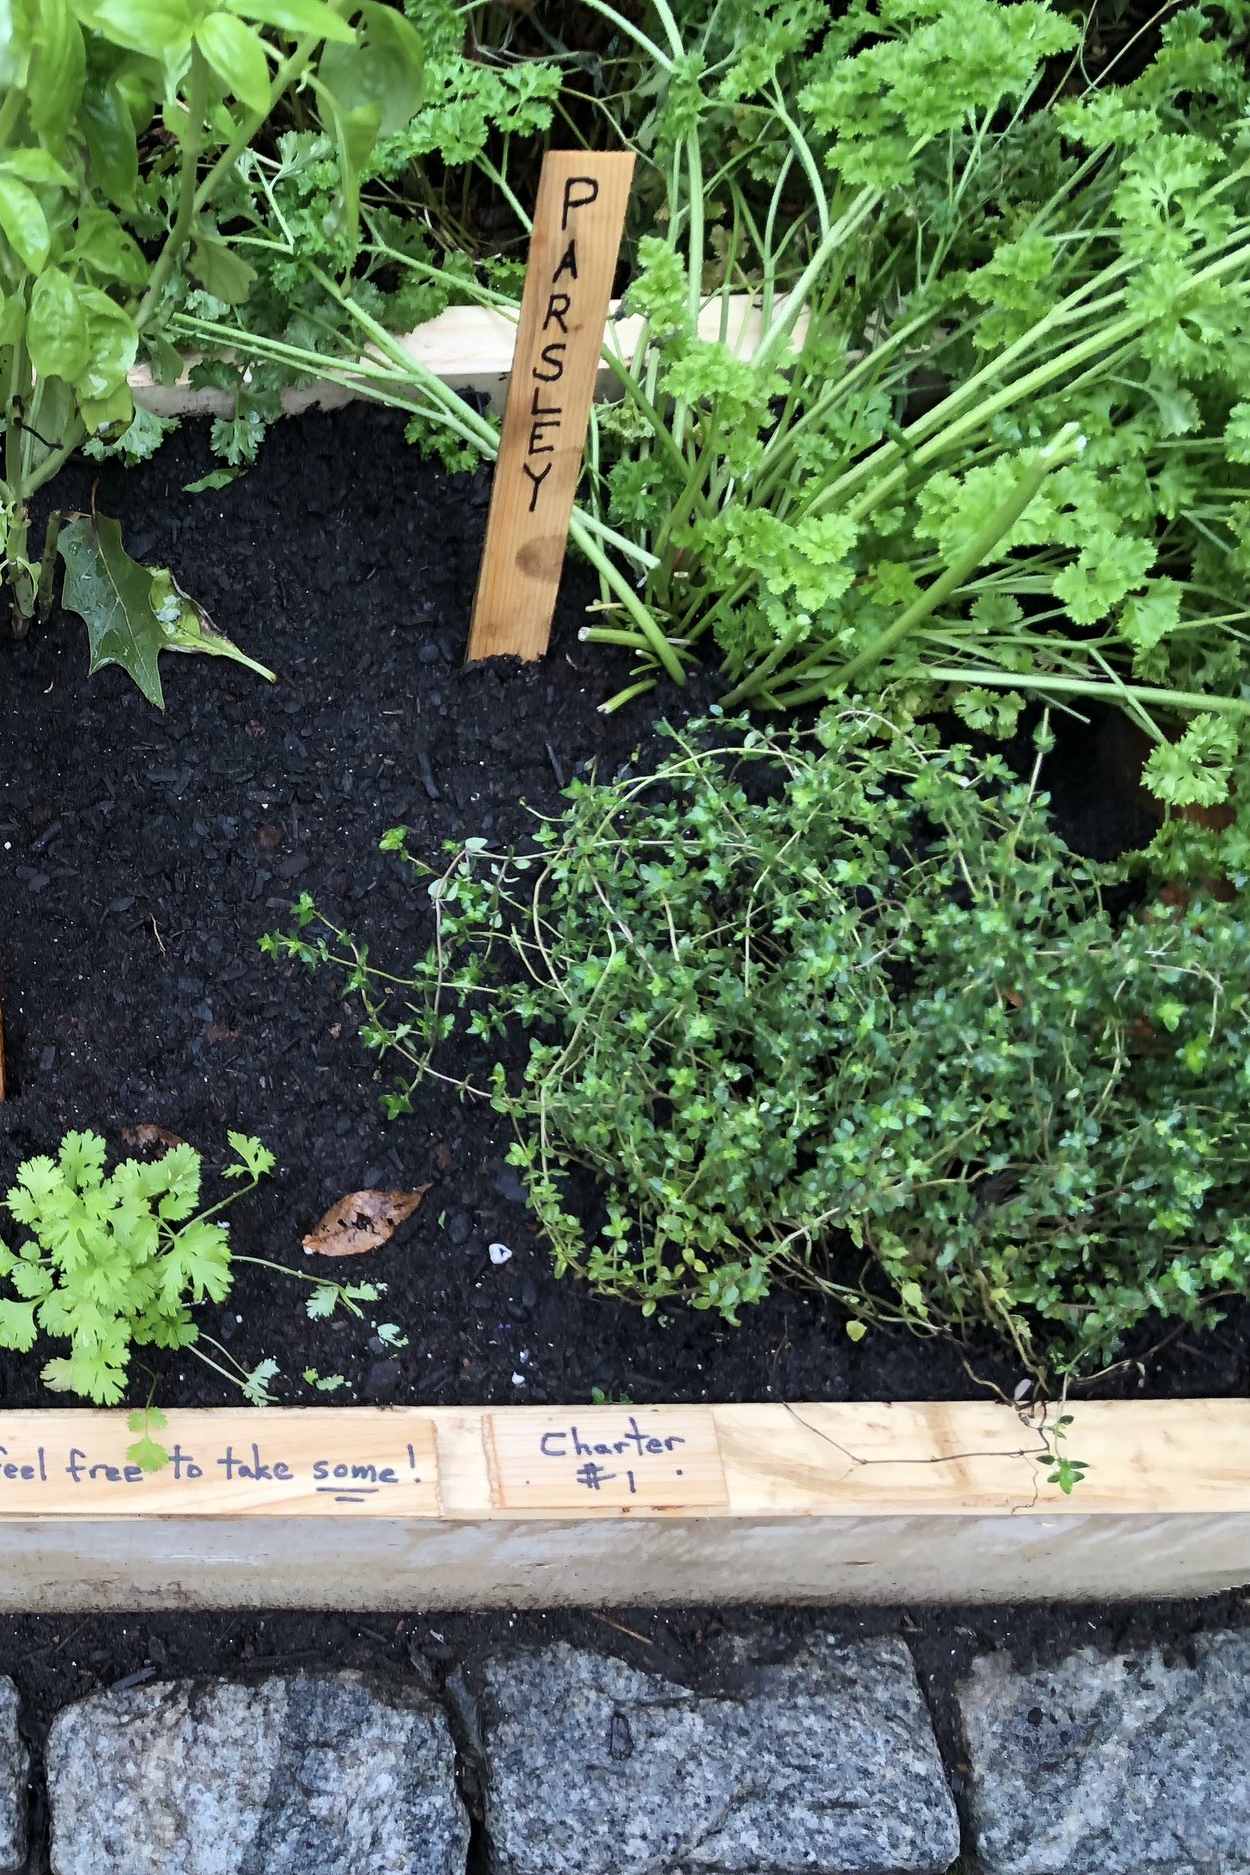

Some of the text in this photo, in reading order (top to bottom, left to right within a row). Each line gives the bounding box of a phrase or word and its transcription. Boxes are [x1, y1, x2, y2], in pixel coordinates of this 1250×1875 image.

[522, 176, 599, 513] PARSLEY
[539, 1415, 687, 1457] Charter
[65, 1447, 145, 1483] free
[167, 1443, 204, 1480] to
[217, 1443, 294, 1482] take
[575, 1461, 637, 1494] #1
